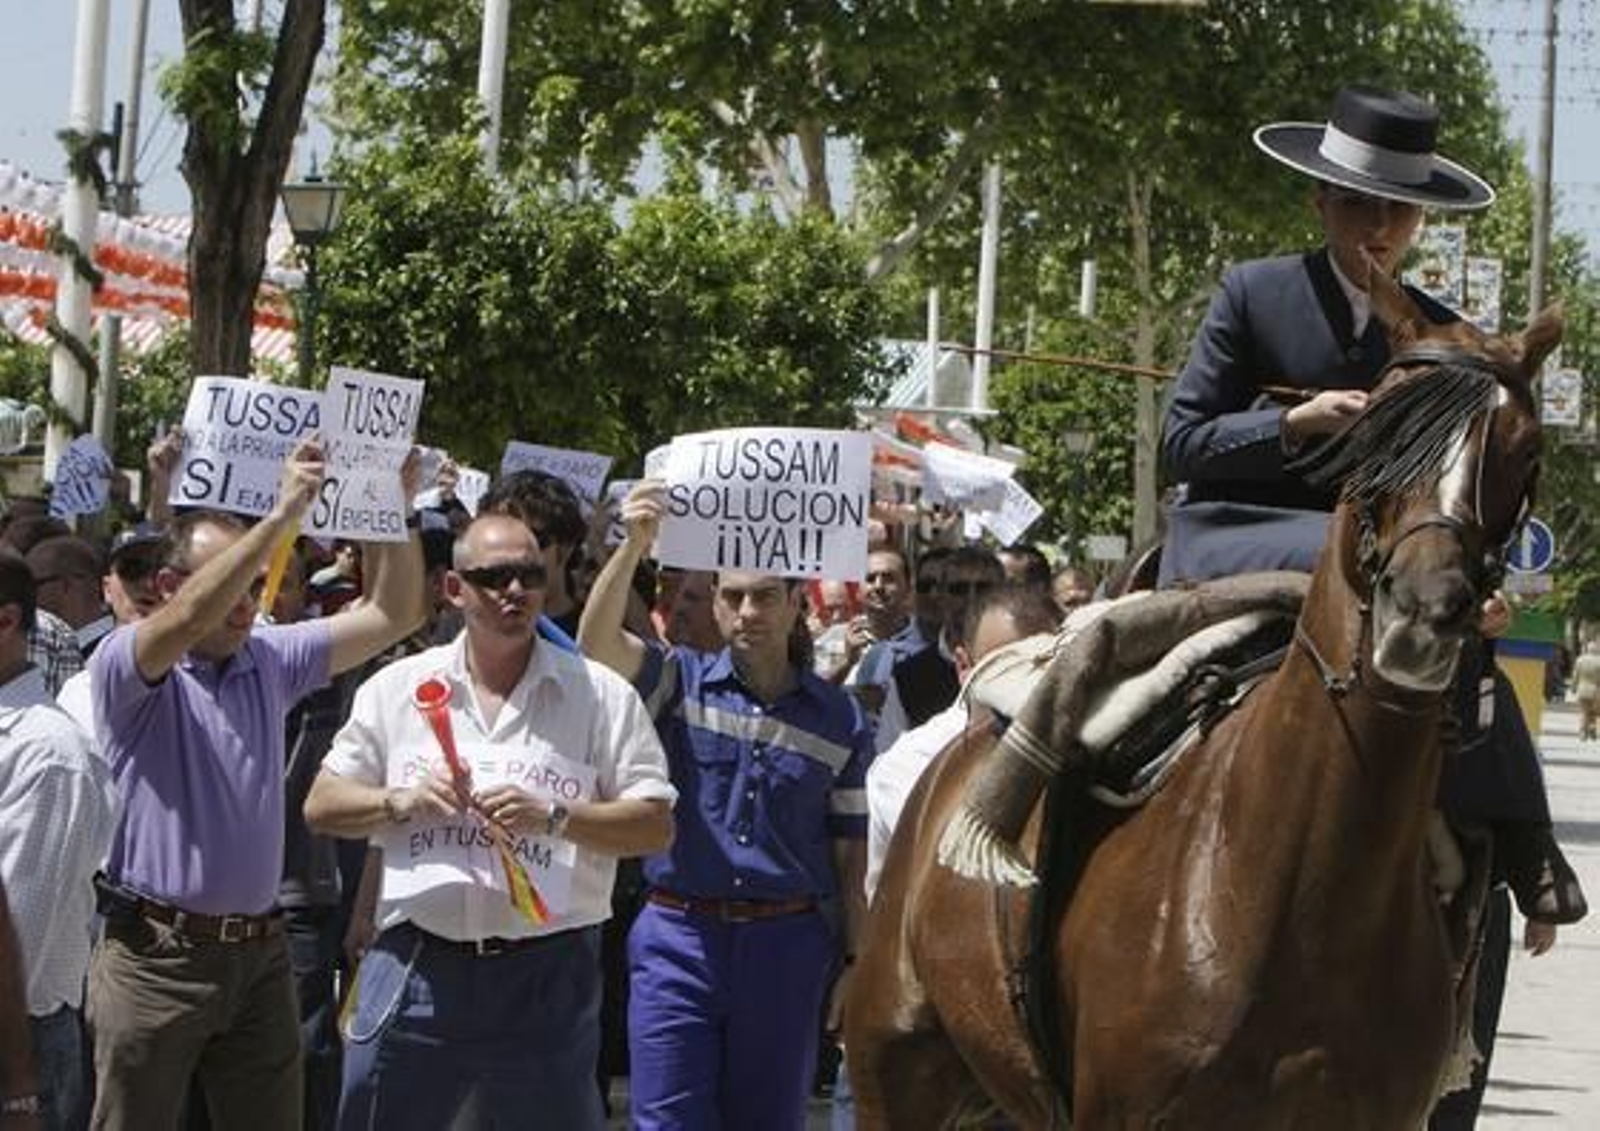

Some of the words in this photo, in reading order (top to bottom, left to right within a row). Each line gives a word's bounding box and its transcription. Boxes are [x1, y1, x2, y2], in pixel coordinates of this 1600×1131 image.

[207, 386, 320, 437] TUSSA
[344, 382, 418, 439] TUSSA
[182, 458, 232, 502] SI
[699, 438, 839, 484] TUSSAM
[667, 484, 864, 537] SOLUCION
[717, 525, 824, 571] ¡¡YA!!
[506, 760, 581, 800] PARO
[410, 828, 435, 859] EN
